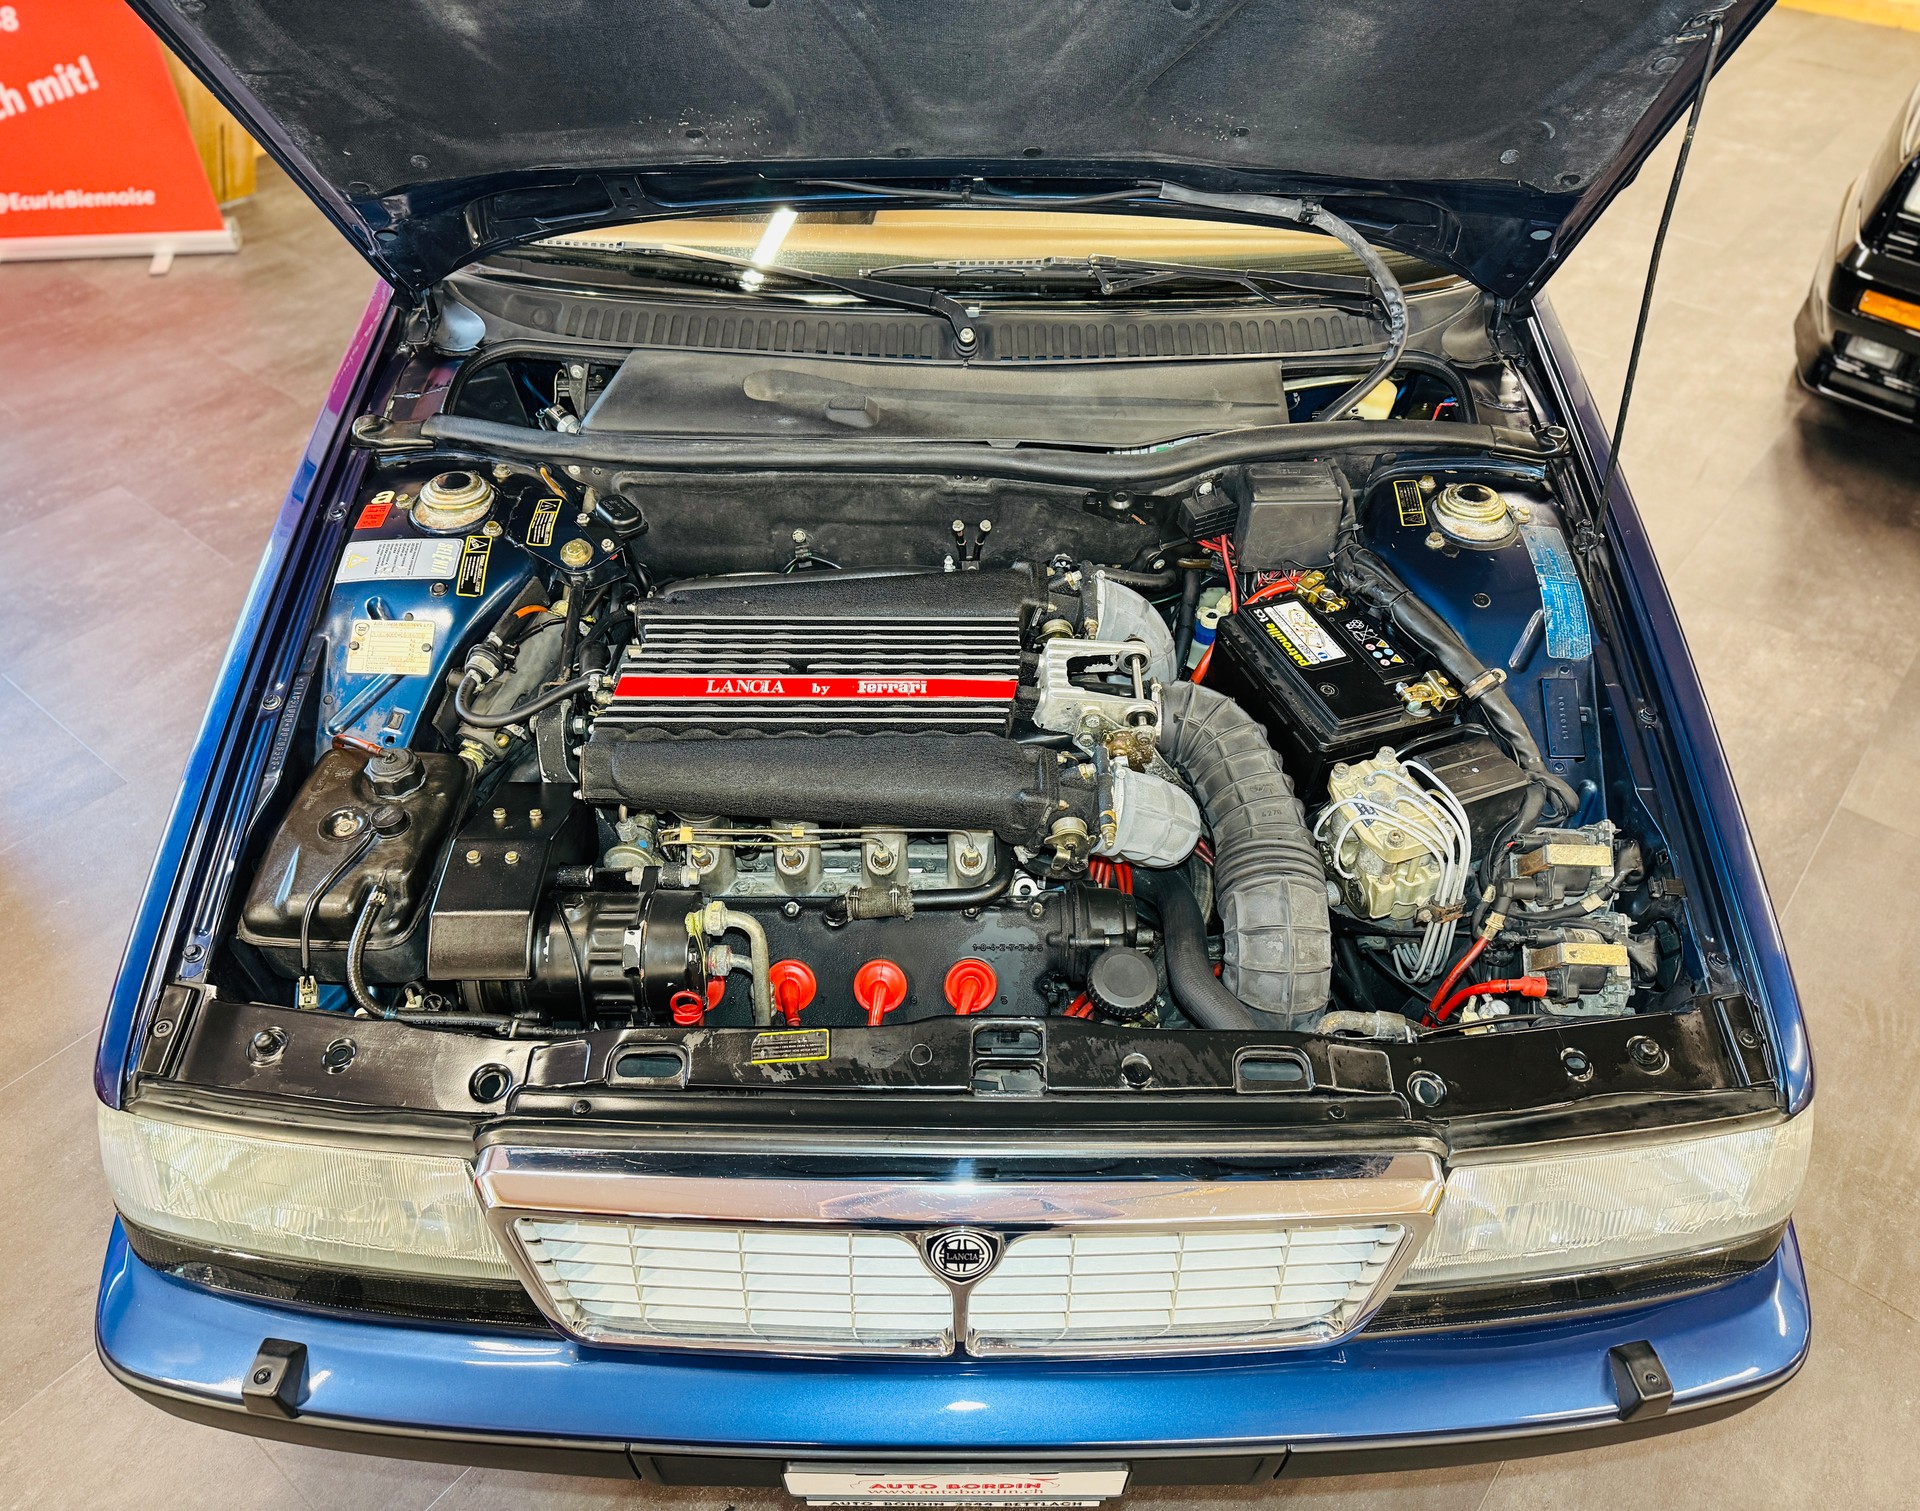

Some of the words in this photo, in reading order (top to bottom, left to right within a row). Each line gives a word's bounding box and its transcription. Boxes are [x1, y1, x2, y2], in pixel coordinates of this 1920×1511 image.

[27, 55, 99, 108] mit!
[1252, 607, 1270, 624] tcs
[1265, 622, 1312, 667] patrouille
[705, 679, 786, 694] LANCIA
[811, 683, 831, 695] by
[856, 680, 928, 695] Ferrari
[946, 1252, 979, 1261] LANCIA
